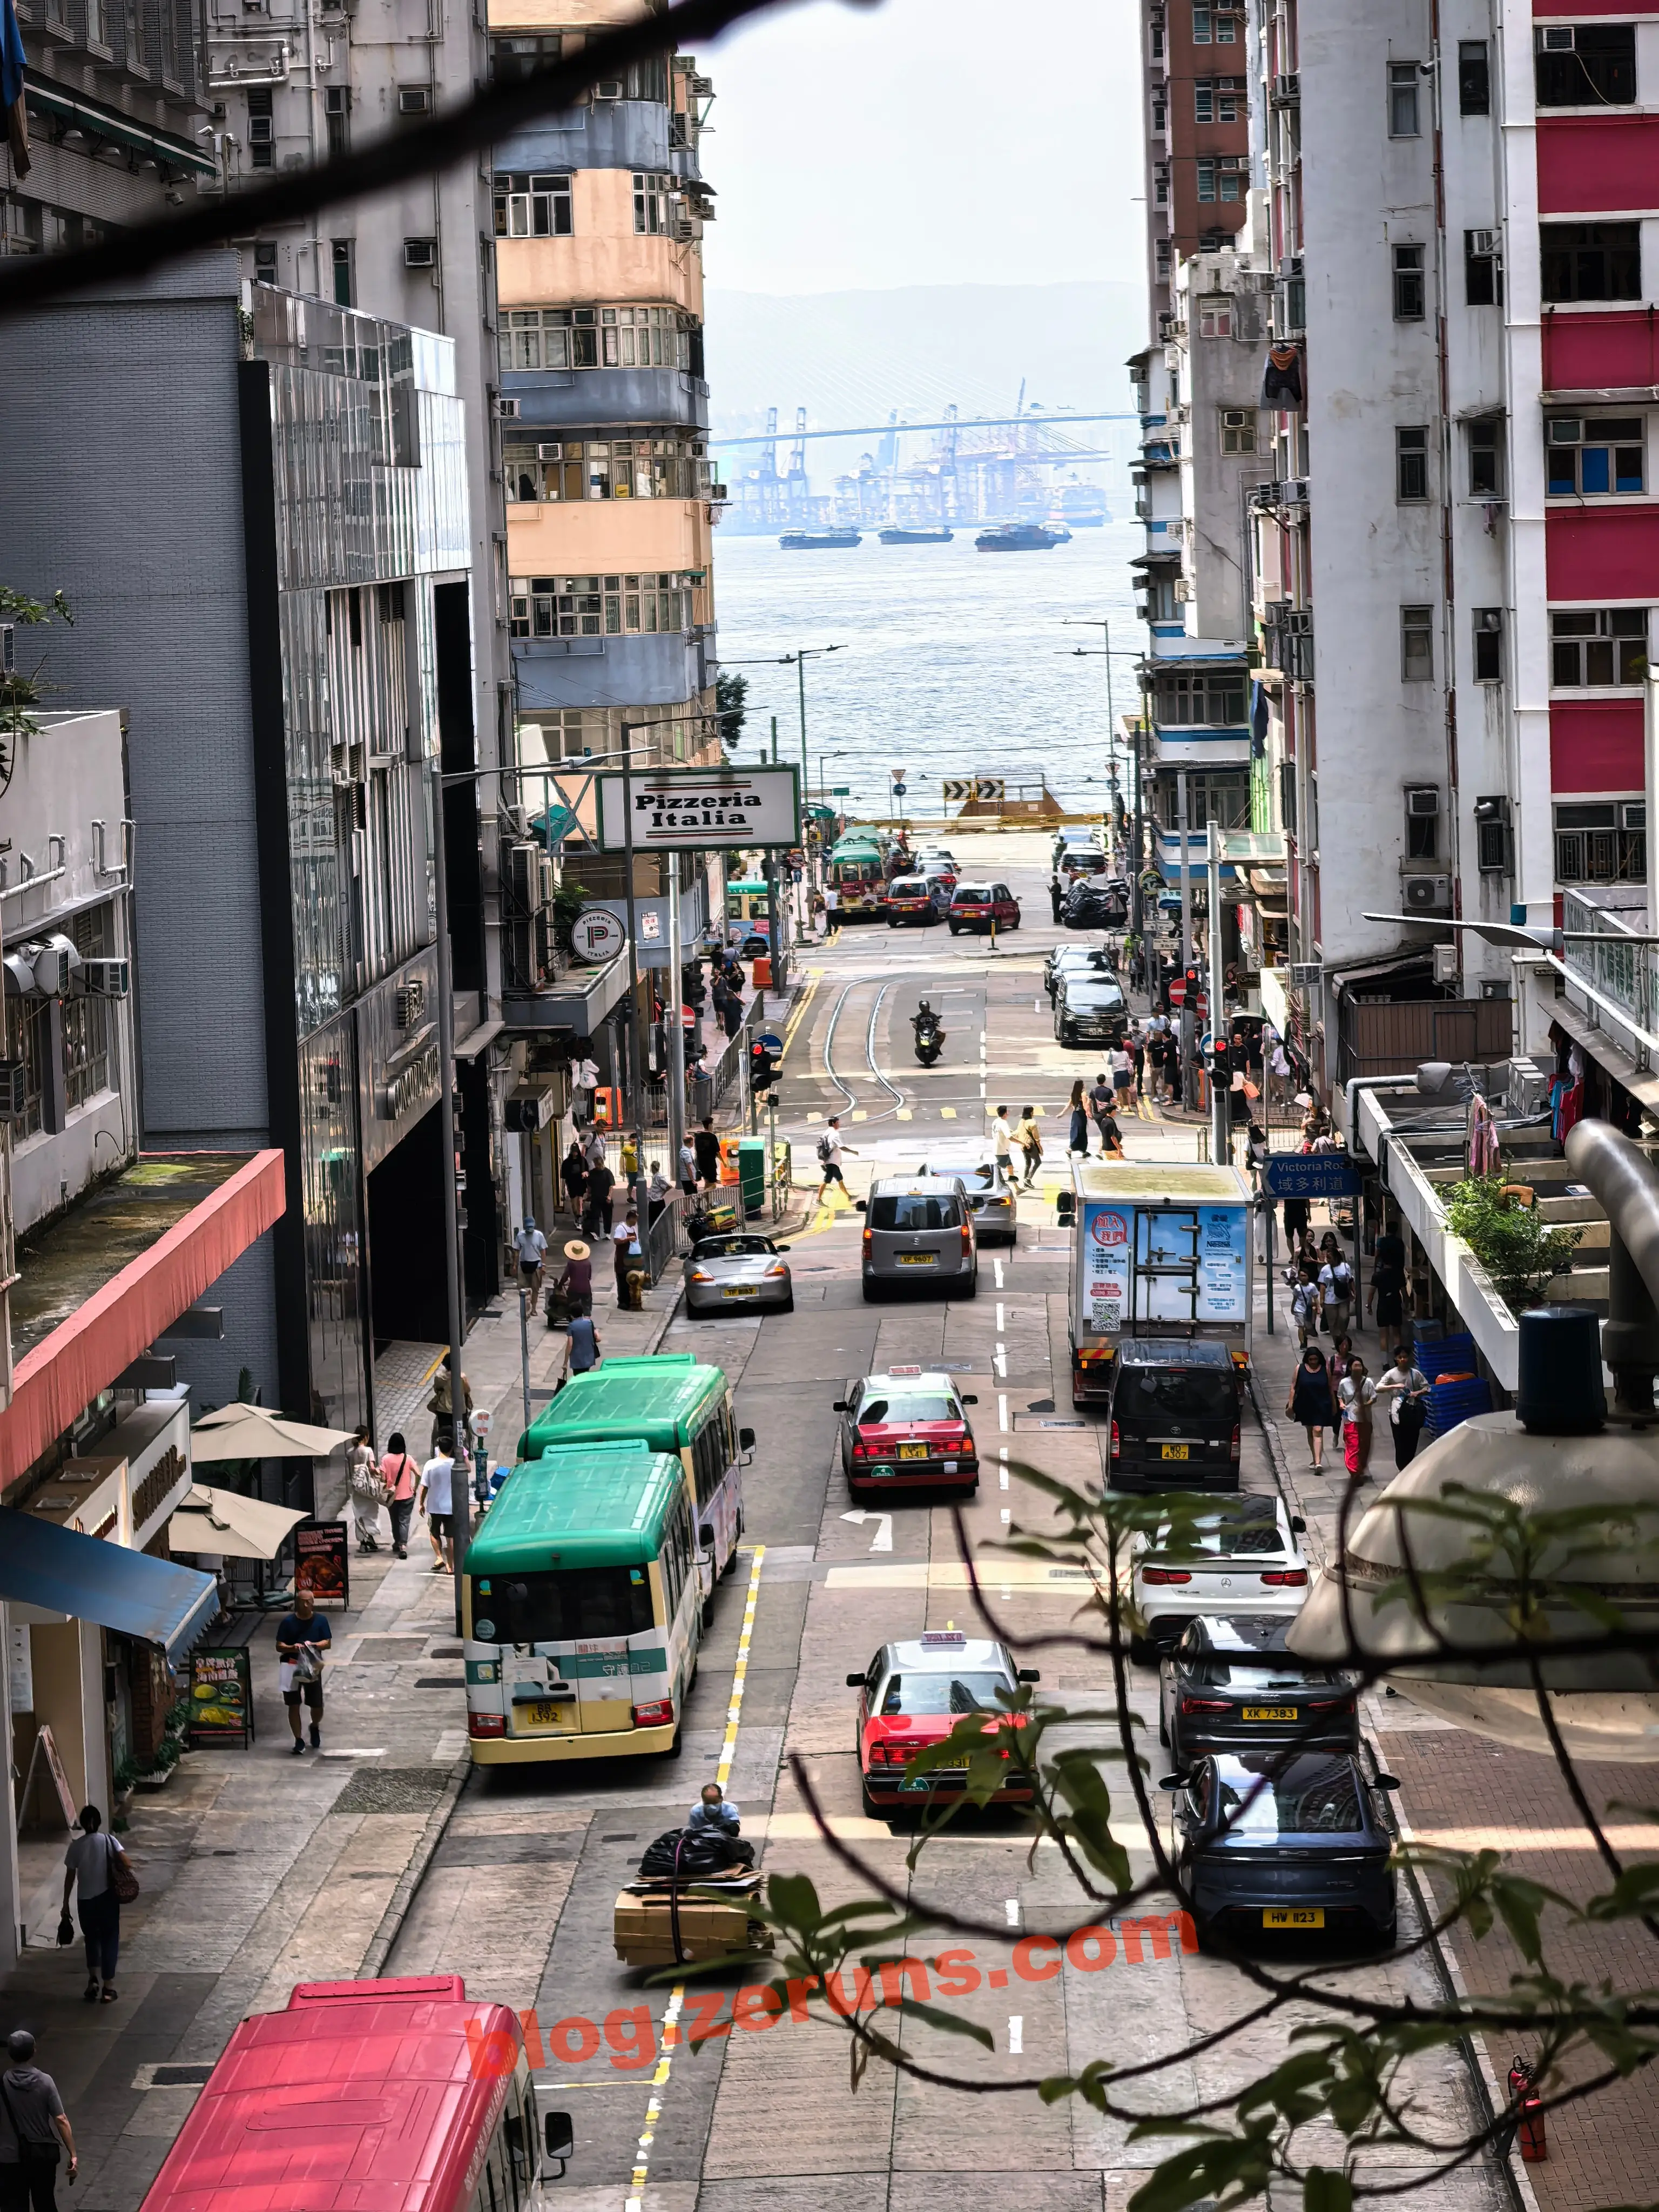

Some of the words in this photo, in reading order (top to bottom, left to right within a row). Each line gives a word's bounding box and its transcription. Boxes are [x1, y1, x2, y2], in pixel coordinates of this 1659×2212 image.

[636, 792, 761, 810] Pizzeria
[652, 811, 746, 827] Italia
[1277, 1162, 1321, 1172] Victoria
[1324, 1161, 1344, 1170] Ro
[1278, 1176, 1344, 1191] 域多利道
[1247, 1708, 1260, 1718] XK
[1264, 1708, 1294, 1718] 7383
[1271, 1912, 1287, 1923] HW
[1293, 1912, 1316, 1923] 1123
